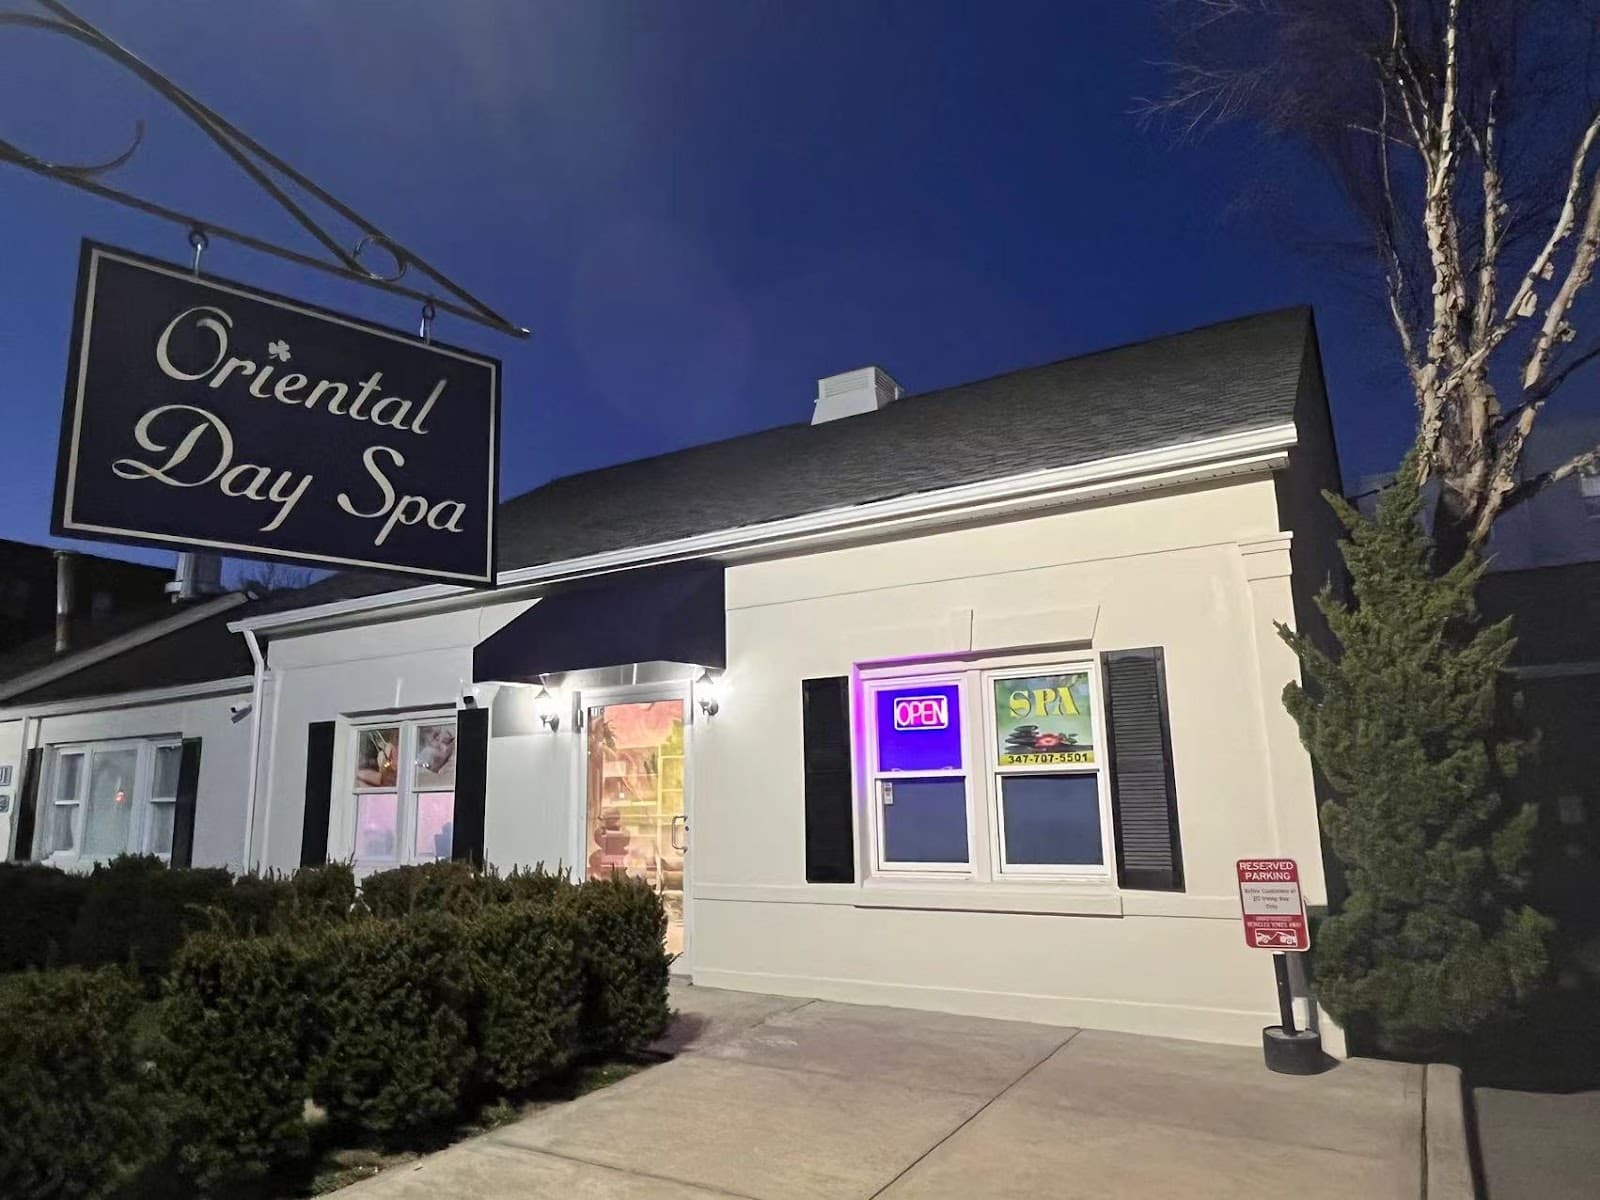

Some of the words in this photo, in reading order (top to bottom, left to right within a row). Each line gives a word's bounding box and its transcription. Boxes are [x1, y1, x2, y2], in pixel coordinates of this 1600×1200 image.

[156, 305, 447, 435] Oriental
[111, 404, 313, 532] Day
[337, 445, 465, 546] Spa
[897, 700, 947, 726] OPEN
[1009, 687, 1080, 718] SPA
[1008, 753, 1088, 764] 347-707-5501
[1239, 861, 1294, 871] RESERVED
[1245, 871, 1291, 881] PARKING
